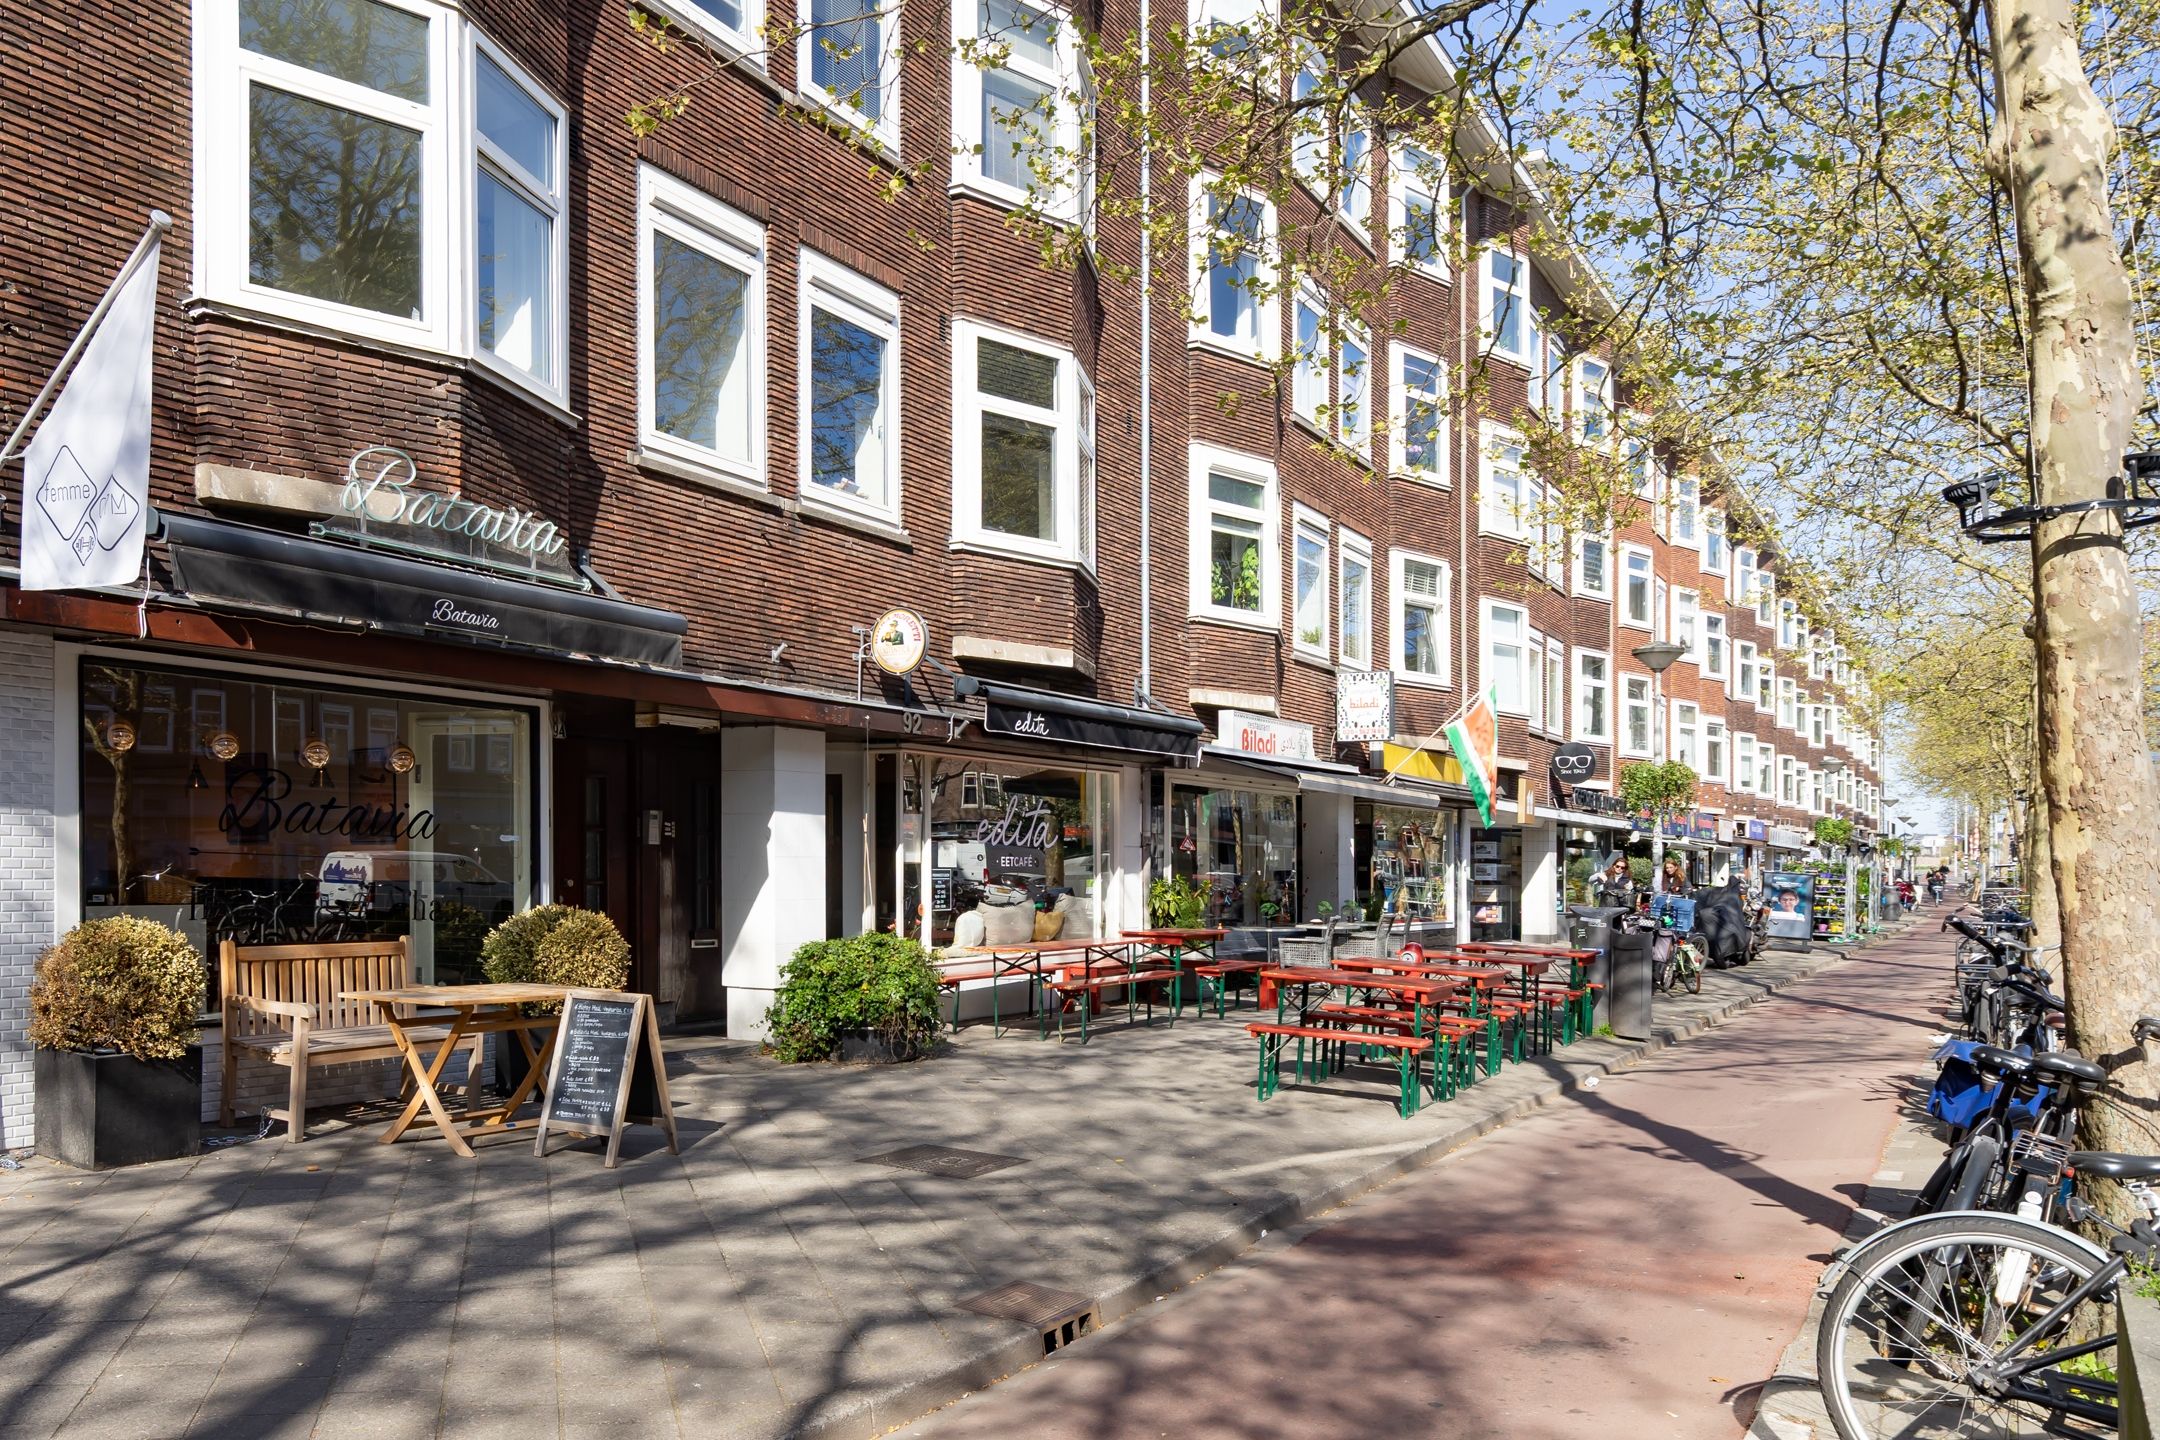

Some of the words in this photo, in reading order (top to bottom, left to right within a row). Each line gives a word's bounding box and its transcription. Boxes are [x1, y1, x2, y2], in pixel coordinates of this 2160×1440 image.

[45, 482, 91, 503] femme
[341, 447, 565, 554] Batavia
[432, 598, 500, 629] Batavia
[903, 711, 922, 735] 92
[1014, 710, 1050, 736] edita
[1241, 728, 1276, 755] Biladi
[218, 767, 441, 840] Batavia
[976, 794, 1059, 849] edita
[1000, 854, 1033, 867] EETCAFÉ
